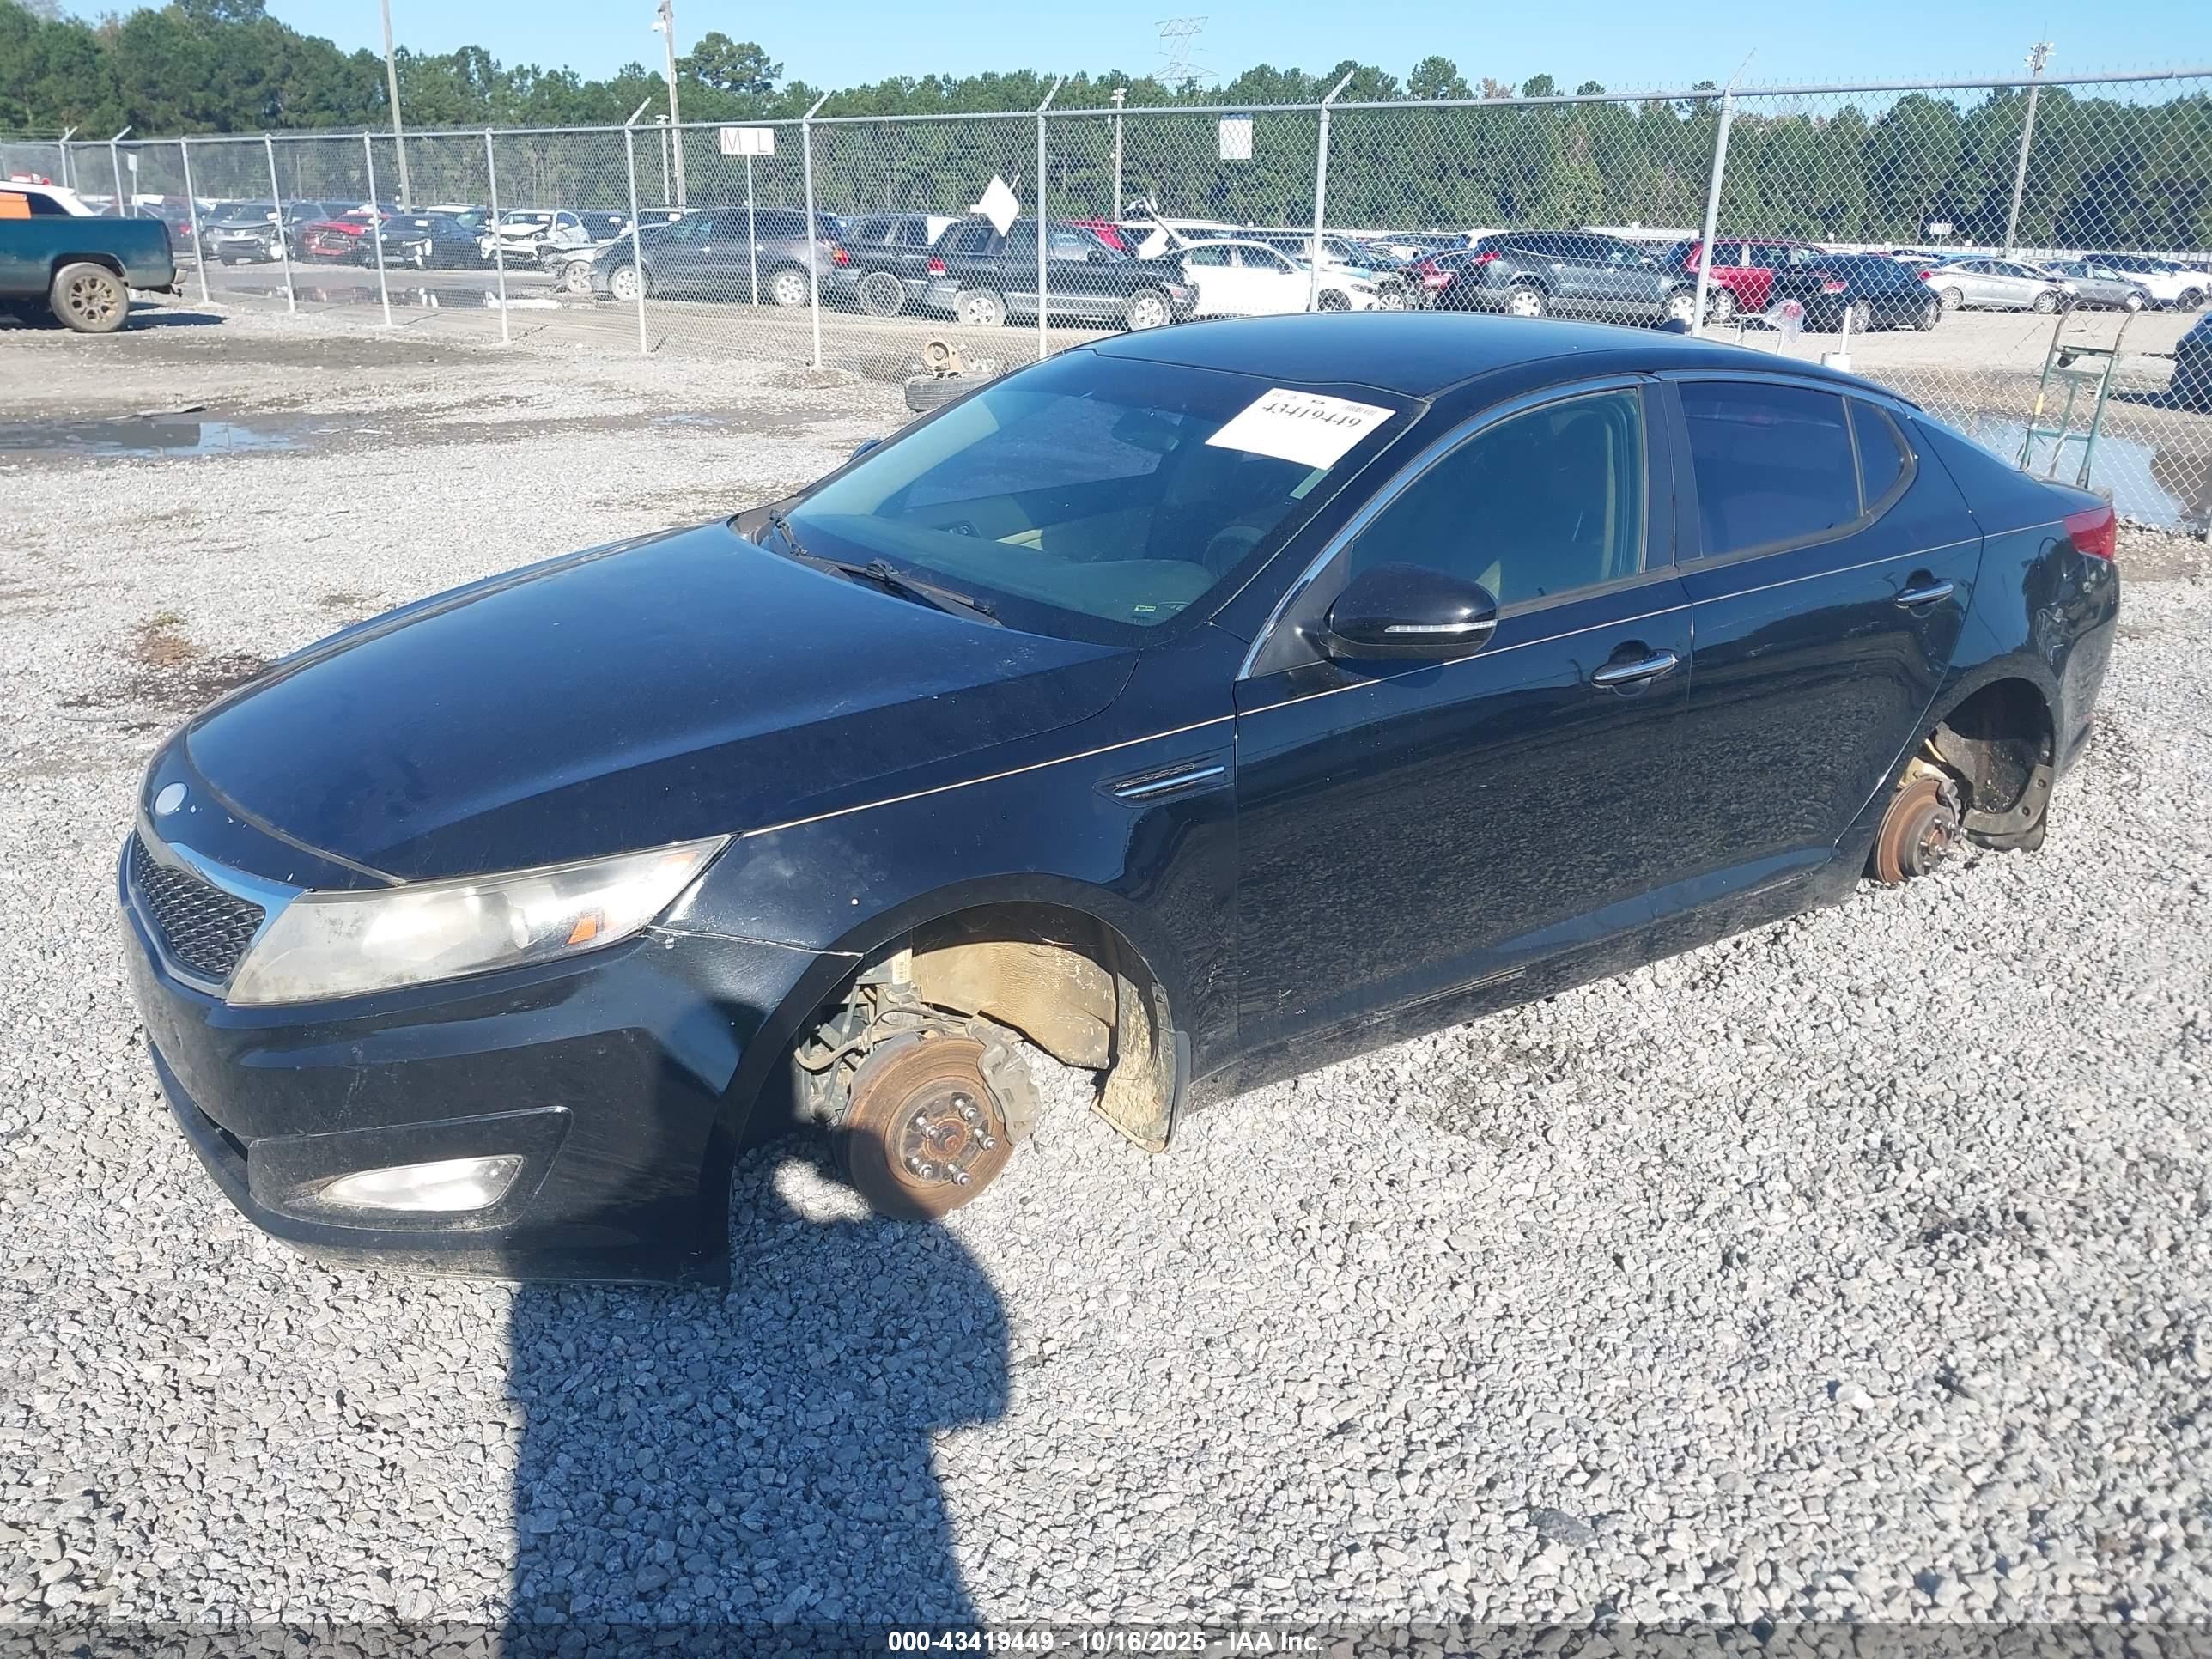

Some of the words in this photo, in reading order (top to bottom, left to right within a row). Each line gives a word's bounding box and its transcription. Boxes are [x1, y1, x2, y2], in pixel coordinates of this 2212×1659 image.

[724, 129, 742, 152] M
[757, 130, 768, 153] L
[1262, 402, 1362, 428] 43419449
